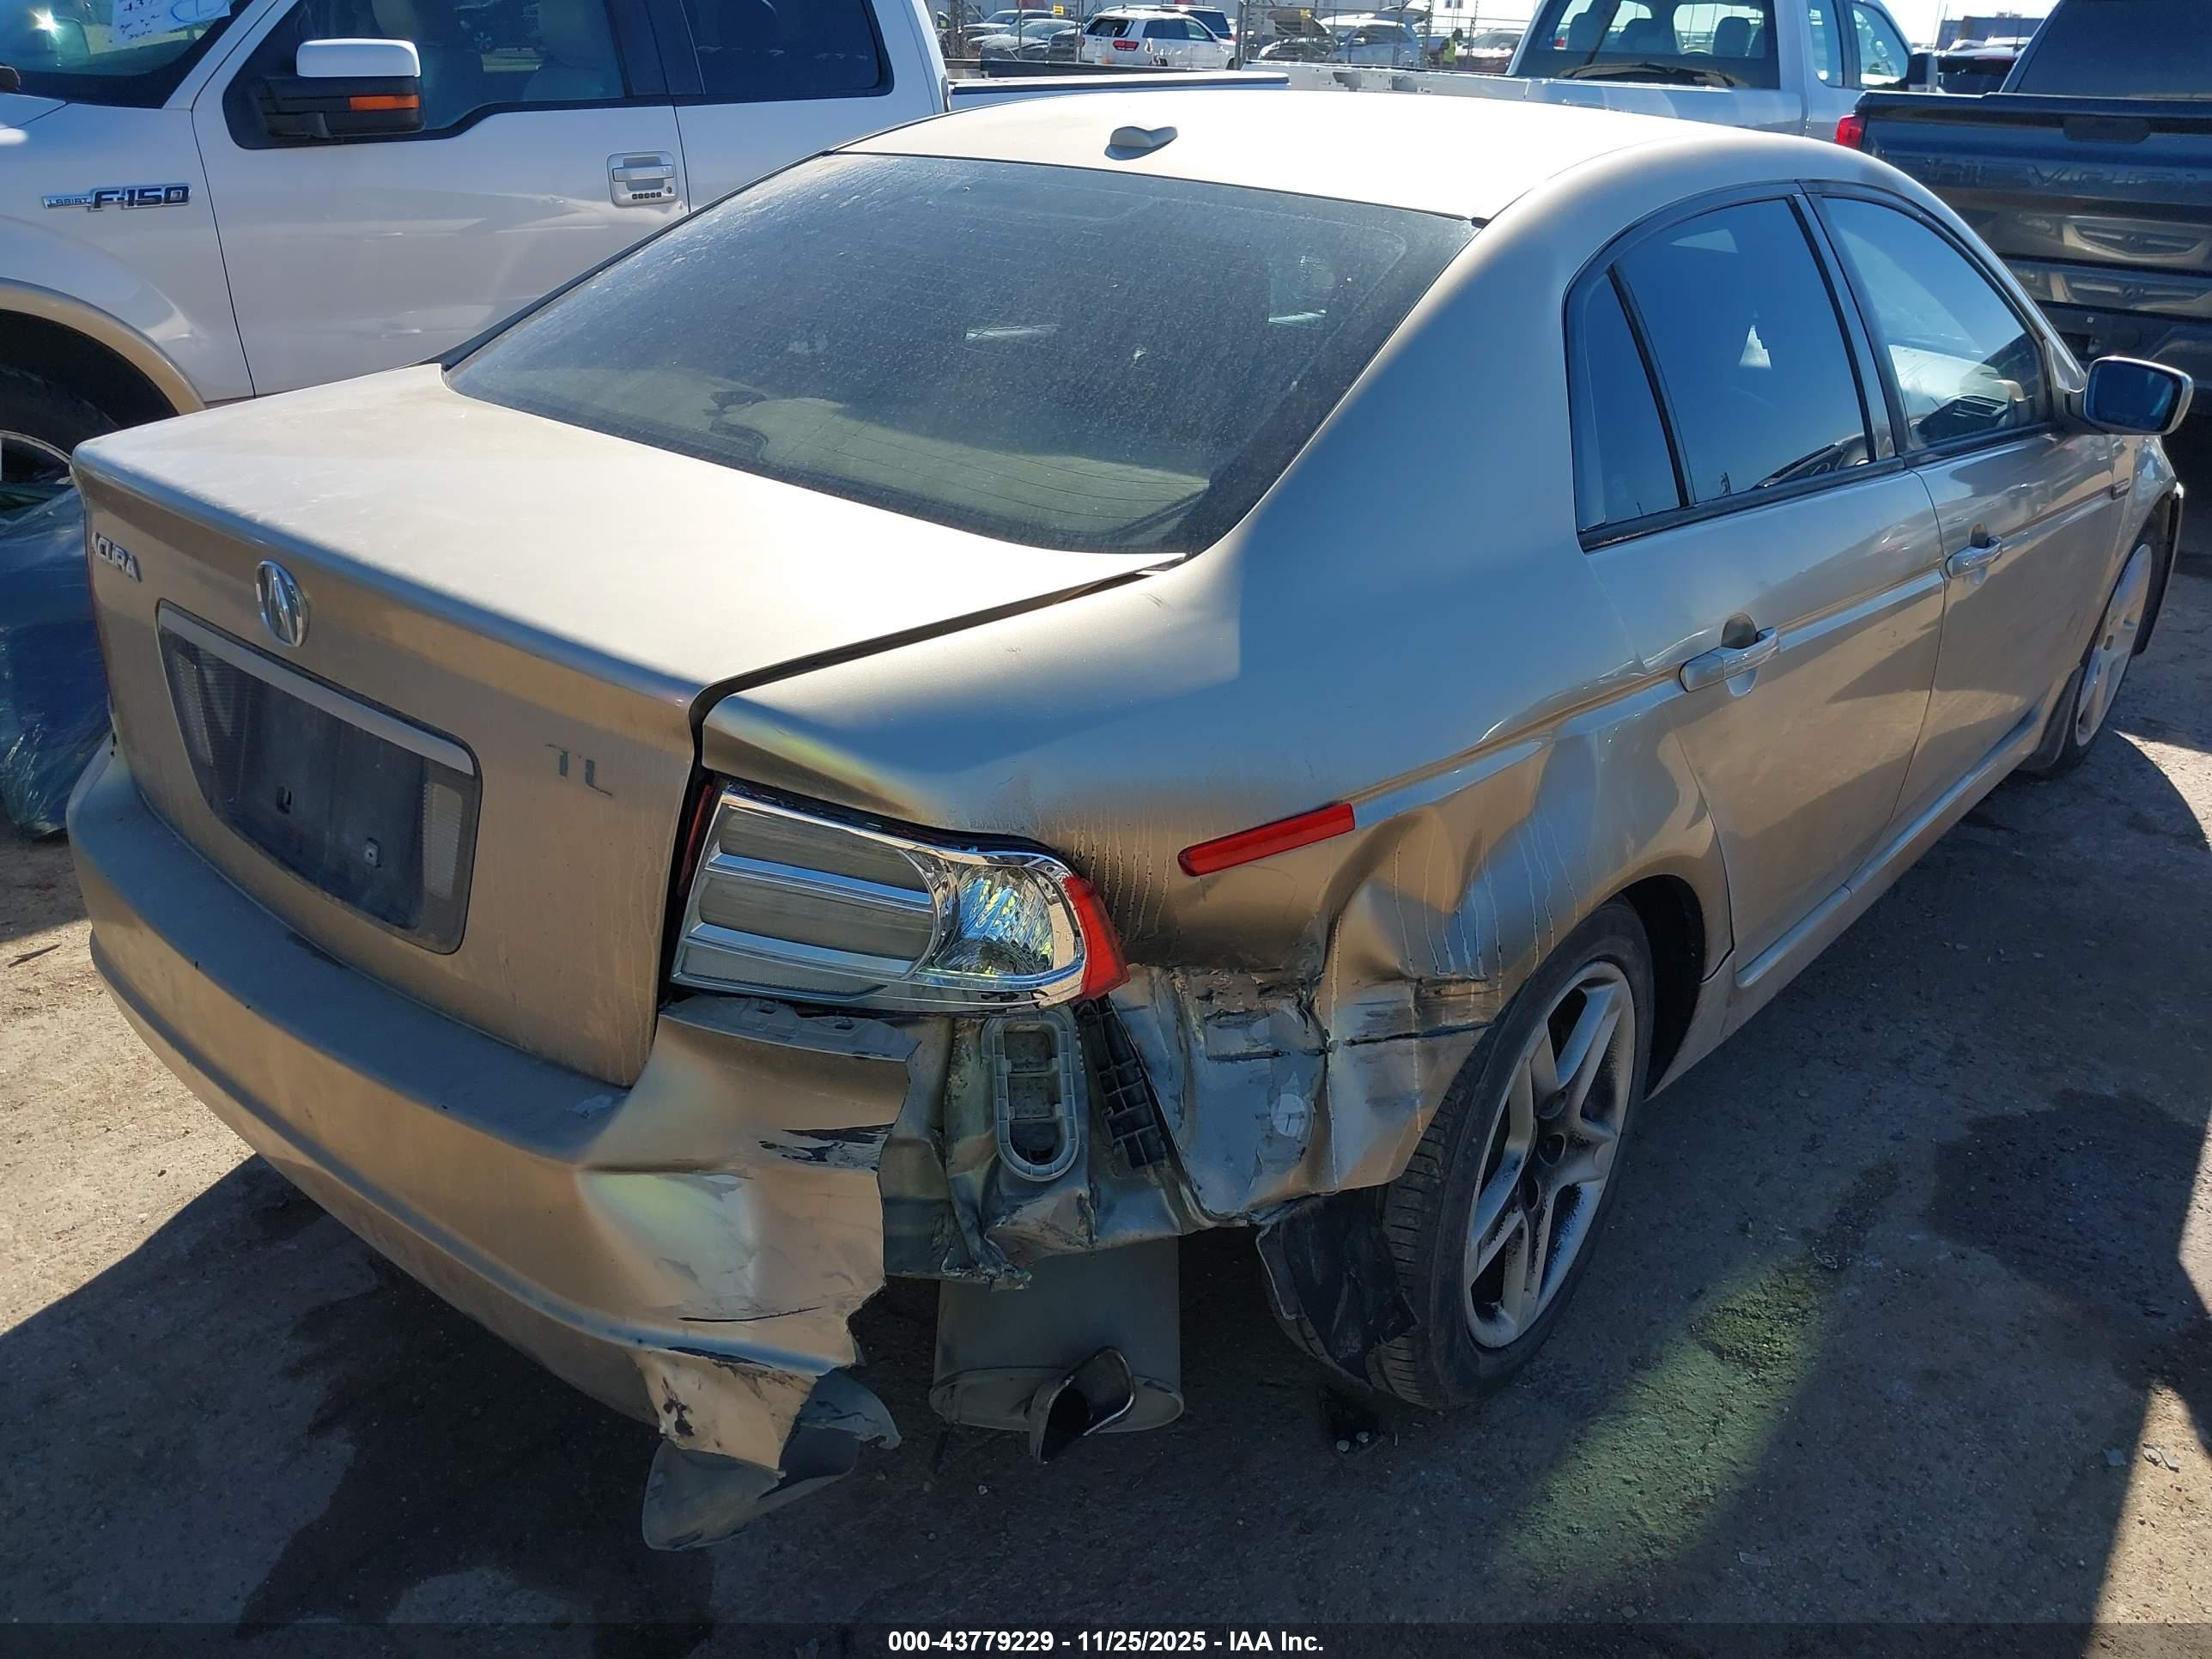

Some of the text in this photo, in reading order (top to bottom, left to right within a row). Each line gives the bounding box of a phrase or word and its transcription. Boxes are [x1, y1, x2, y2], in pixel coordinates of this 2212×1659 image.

[90, 185, 191, 210] F-150
[91, 532, 142, 583] ACURA
[544, 743, 613, 797] TL
